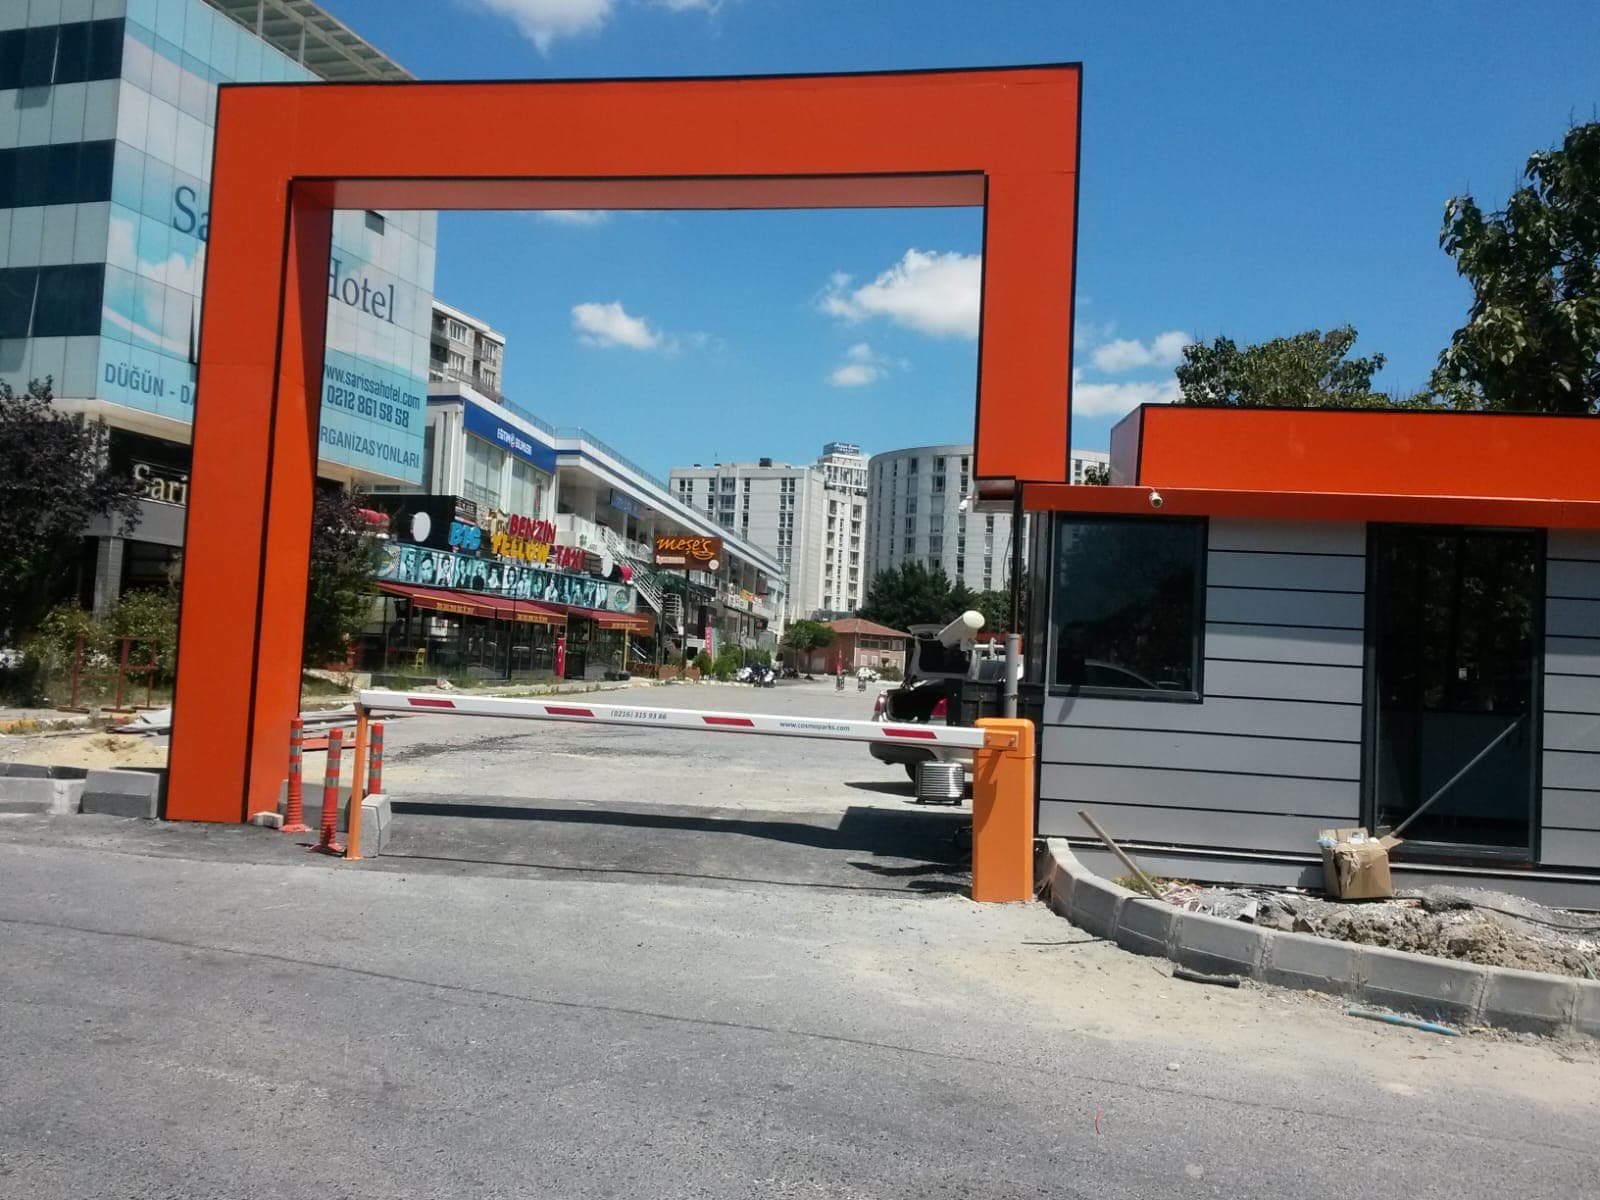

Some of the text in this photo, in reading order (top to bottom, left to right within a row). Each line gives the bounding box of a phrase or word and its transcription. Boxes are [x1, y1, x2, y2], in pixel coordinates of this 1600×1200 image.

[104, 362, 164, 397] DÜĞÜN
[181, 384, 193, 406] D
[327, 385, 410, 428] 0212 861 58 58
[449, 521, 586, 570] BIG YELLOW TAXI
